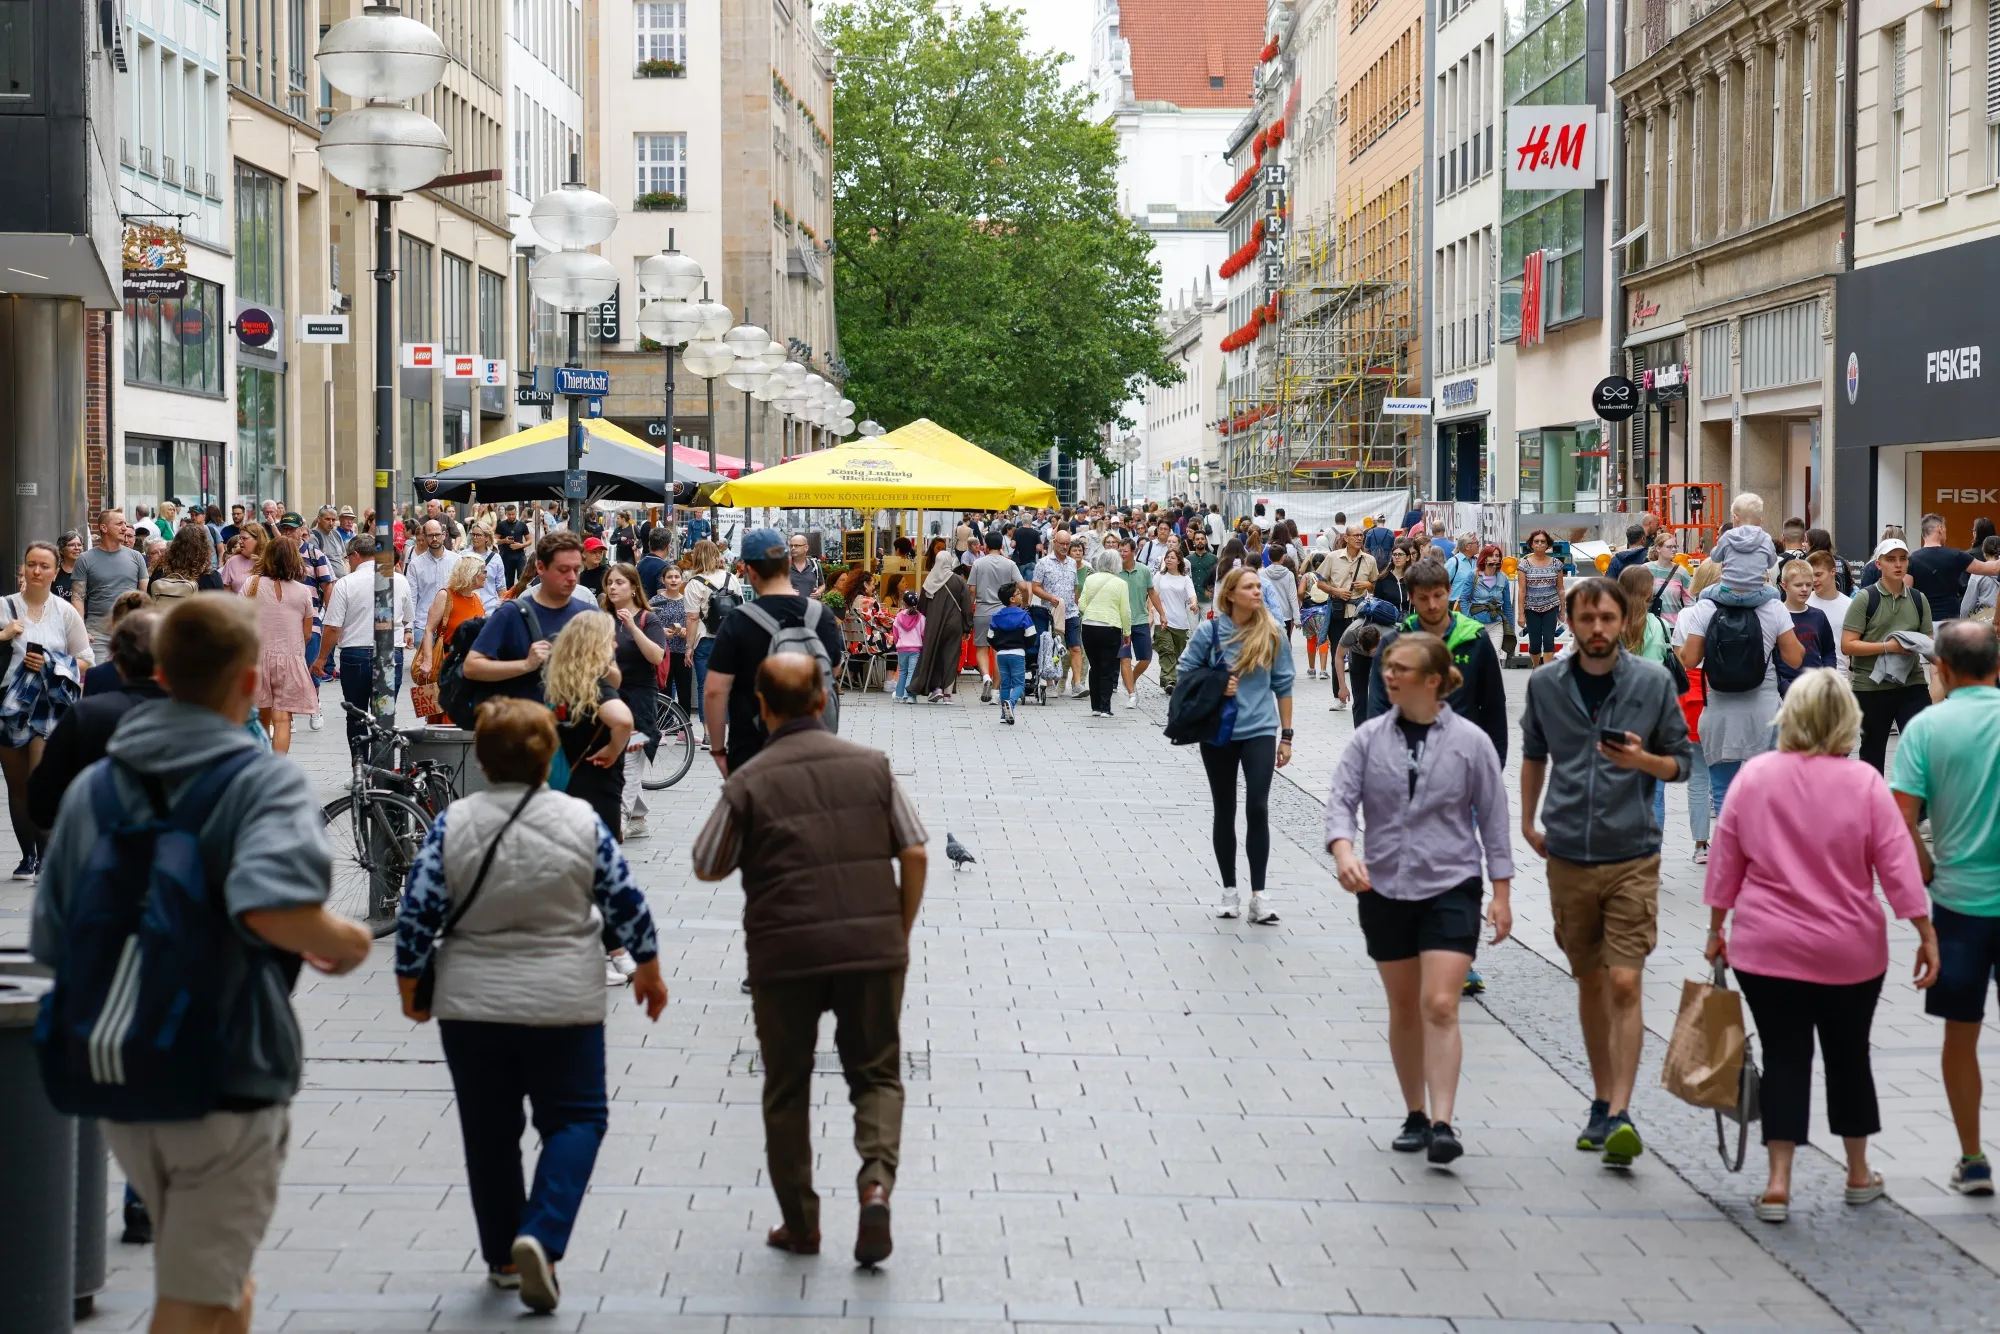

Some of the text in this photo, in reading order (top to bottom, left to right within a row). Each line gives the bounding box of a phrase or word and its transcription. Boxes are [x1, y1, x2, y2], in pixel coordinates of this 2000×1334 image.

[1516, 123, 1587, 172] H&M
[415, 352, 432, 360] LEGO
[457, 363, 472, 371] LEGO
[1926, 346, 1981, 384] FISKER
[561, 370, 607, 391] Thiereckstr.
[828, 468, 913, 479] König Ludwig
[788, 492, 952, 502] BIER VON KÖNIGLICHER HOHEIT
[1936, 488, 1999, 504] FISK
[411, 686, 425, 698] FC
[413, 695, 433, 708] BAY
[415, 704, 438, 718] ERN
